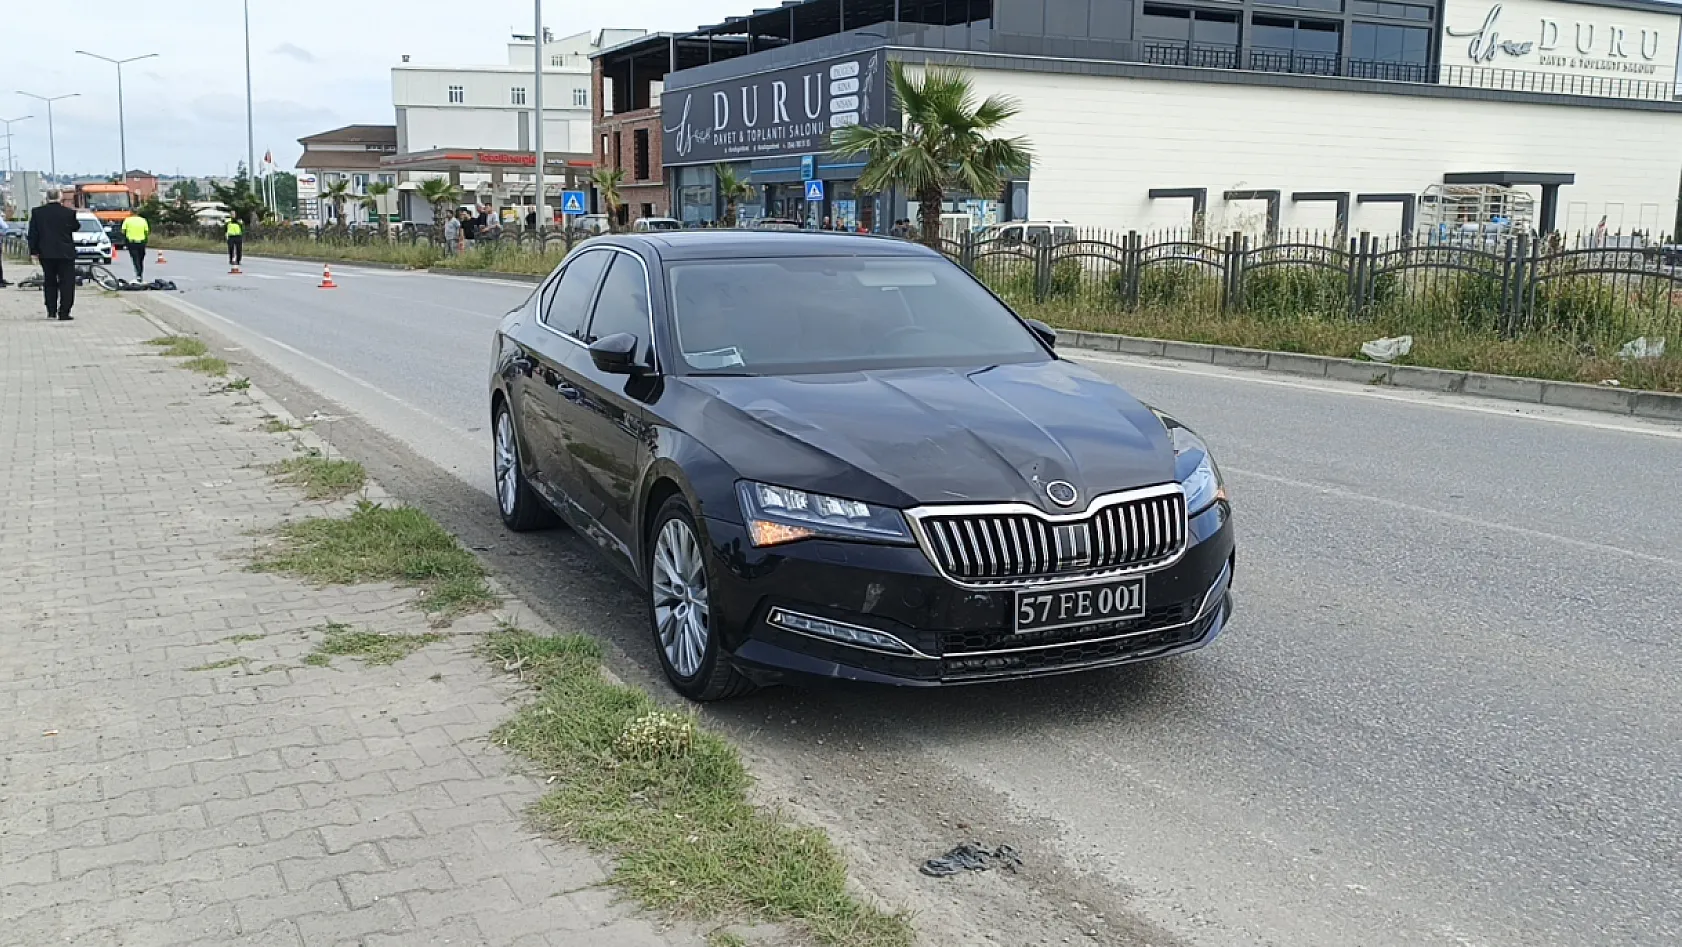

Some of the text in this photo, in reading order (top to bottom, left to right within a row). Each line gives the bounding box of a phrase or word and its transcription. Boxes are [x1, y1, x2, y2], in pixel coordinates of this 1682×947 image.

[1539, 18, 1659, 61] DURU
[1539, 55, 1566, 67] DAVET
[713, 72, 823, 132] DURU
[713, 121, 824, 146] DAVET & TOPLANTI SALONU
[477, 152, 542, 167] TotalEnergie
[1018, 583, 1142, 625] 57 FE 001
